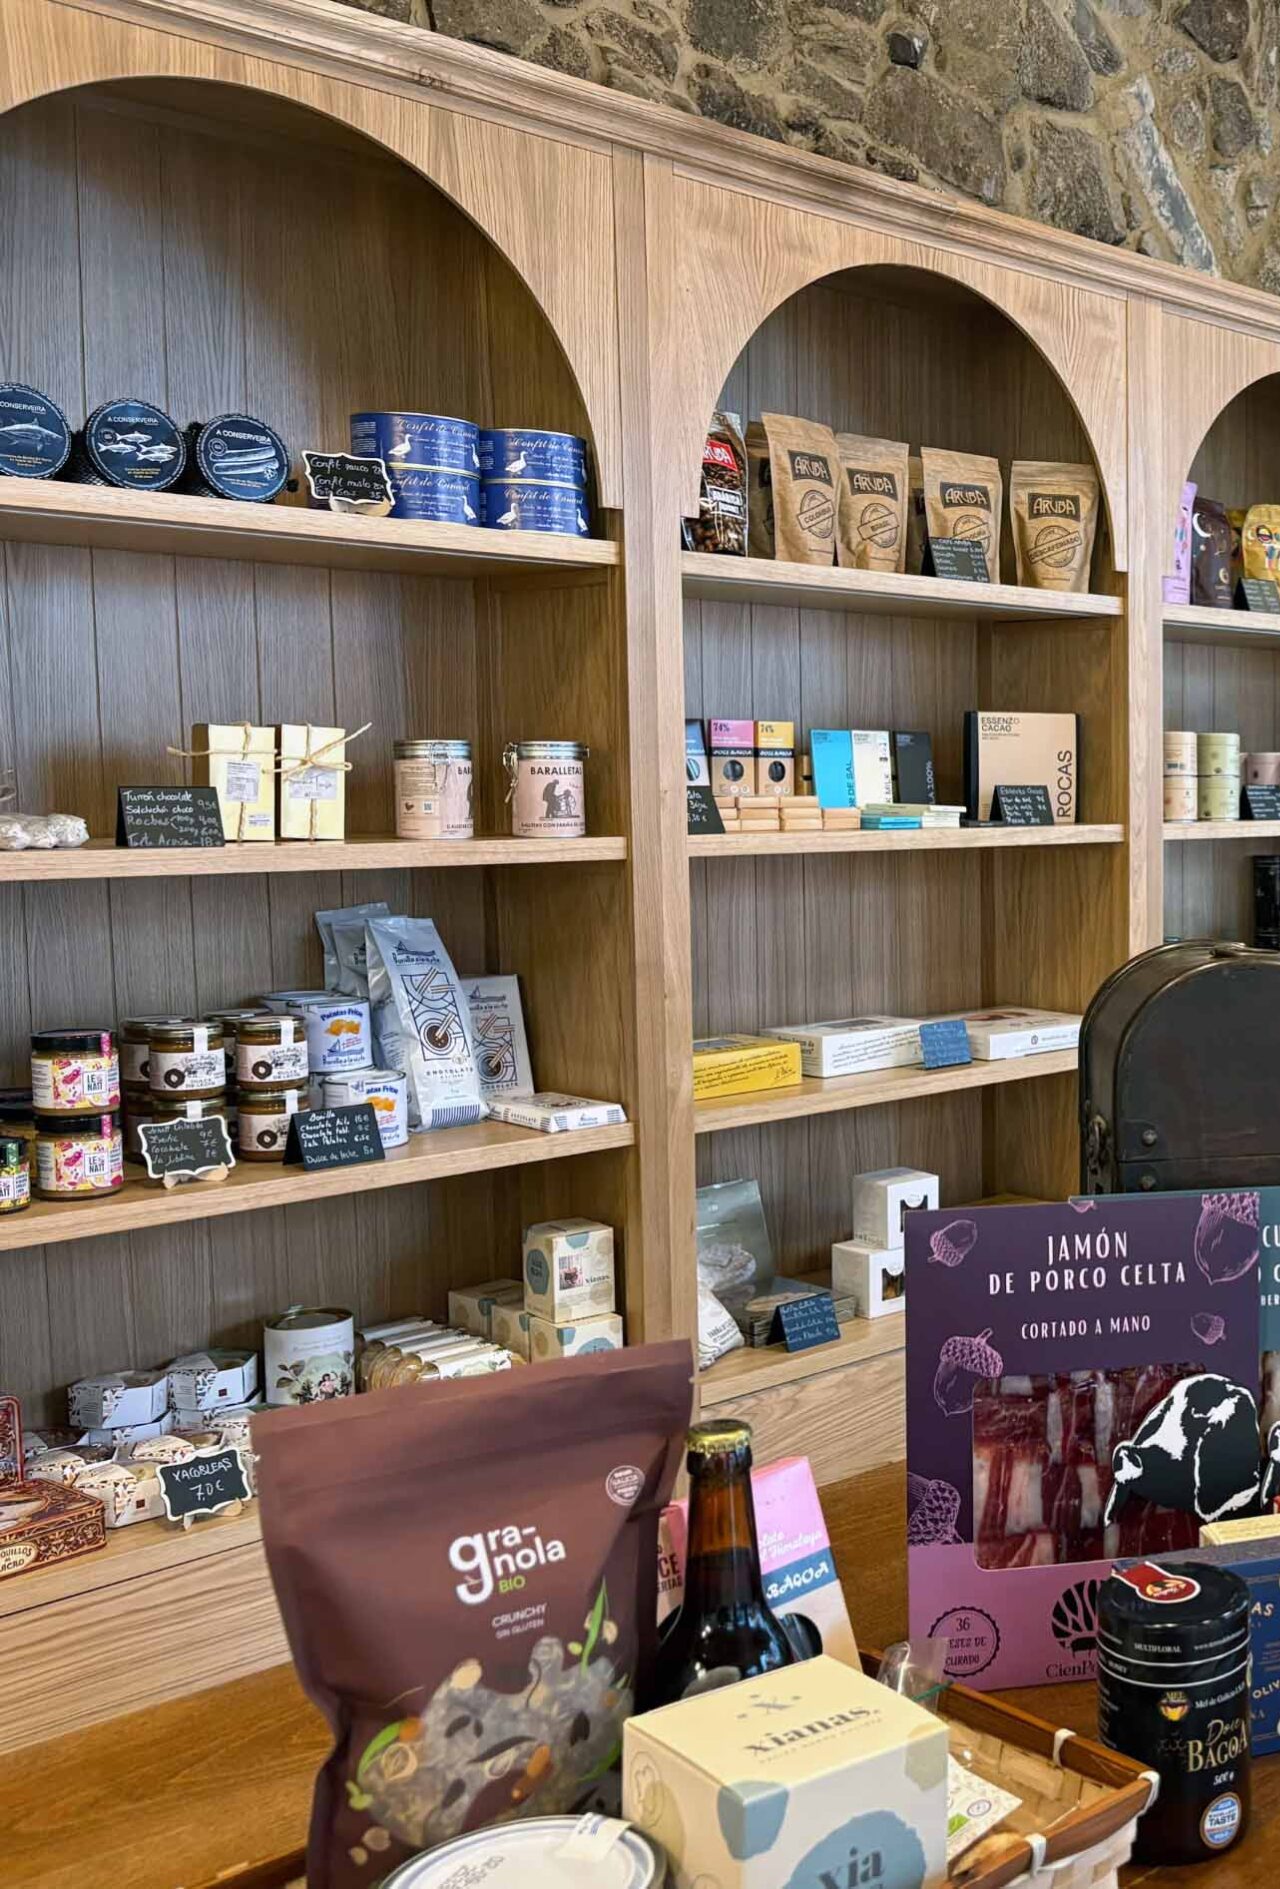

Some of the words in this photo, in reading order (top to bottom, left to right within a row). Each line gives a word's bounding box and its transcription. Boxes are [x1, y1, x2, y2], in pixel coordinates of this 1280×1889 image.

[795, 456, 829, 480] ARUBA
[853, 474, 894, 494] ARUBA
[945, 487, 987, 505] ARUBA
[1033, 497, 1076, 516] ARUBA
[713, 722, 730, 732] 74%
[760, 724, 774, 733] 74%
[981, 724, 1012, 732] CACAO
[1056, 750, 1073, 818] ROCAS
[1047, 1228, 1128, 1266] JAMÓN
[988, 1272, 1015, 1296] DE
[1030, 1267, 1107, 1293] PORCO
[1120, 1262, 1187, 1286] CELTA
[1021, 1320, 1087, 1340] CORTADO
[1094, 1320, 1102, 1336] A
[1110, 1315, 1151, 1335] MANO
[499, 1574, 526, 1594] BIO
[766, 1561, 829, 1599] BAGOA
[491, 1602, 548, 1628] CRUNCHY
[956, 1616, 970, 1632] 36
[1187, 1720, 1248, 1773] BAGOA
[1208, 1812, 1237, 1827] TASTE
